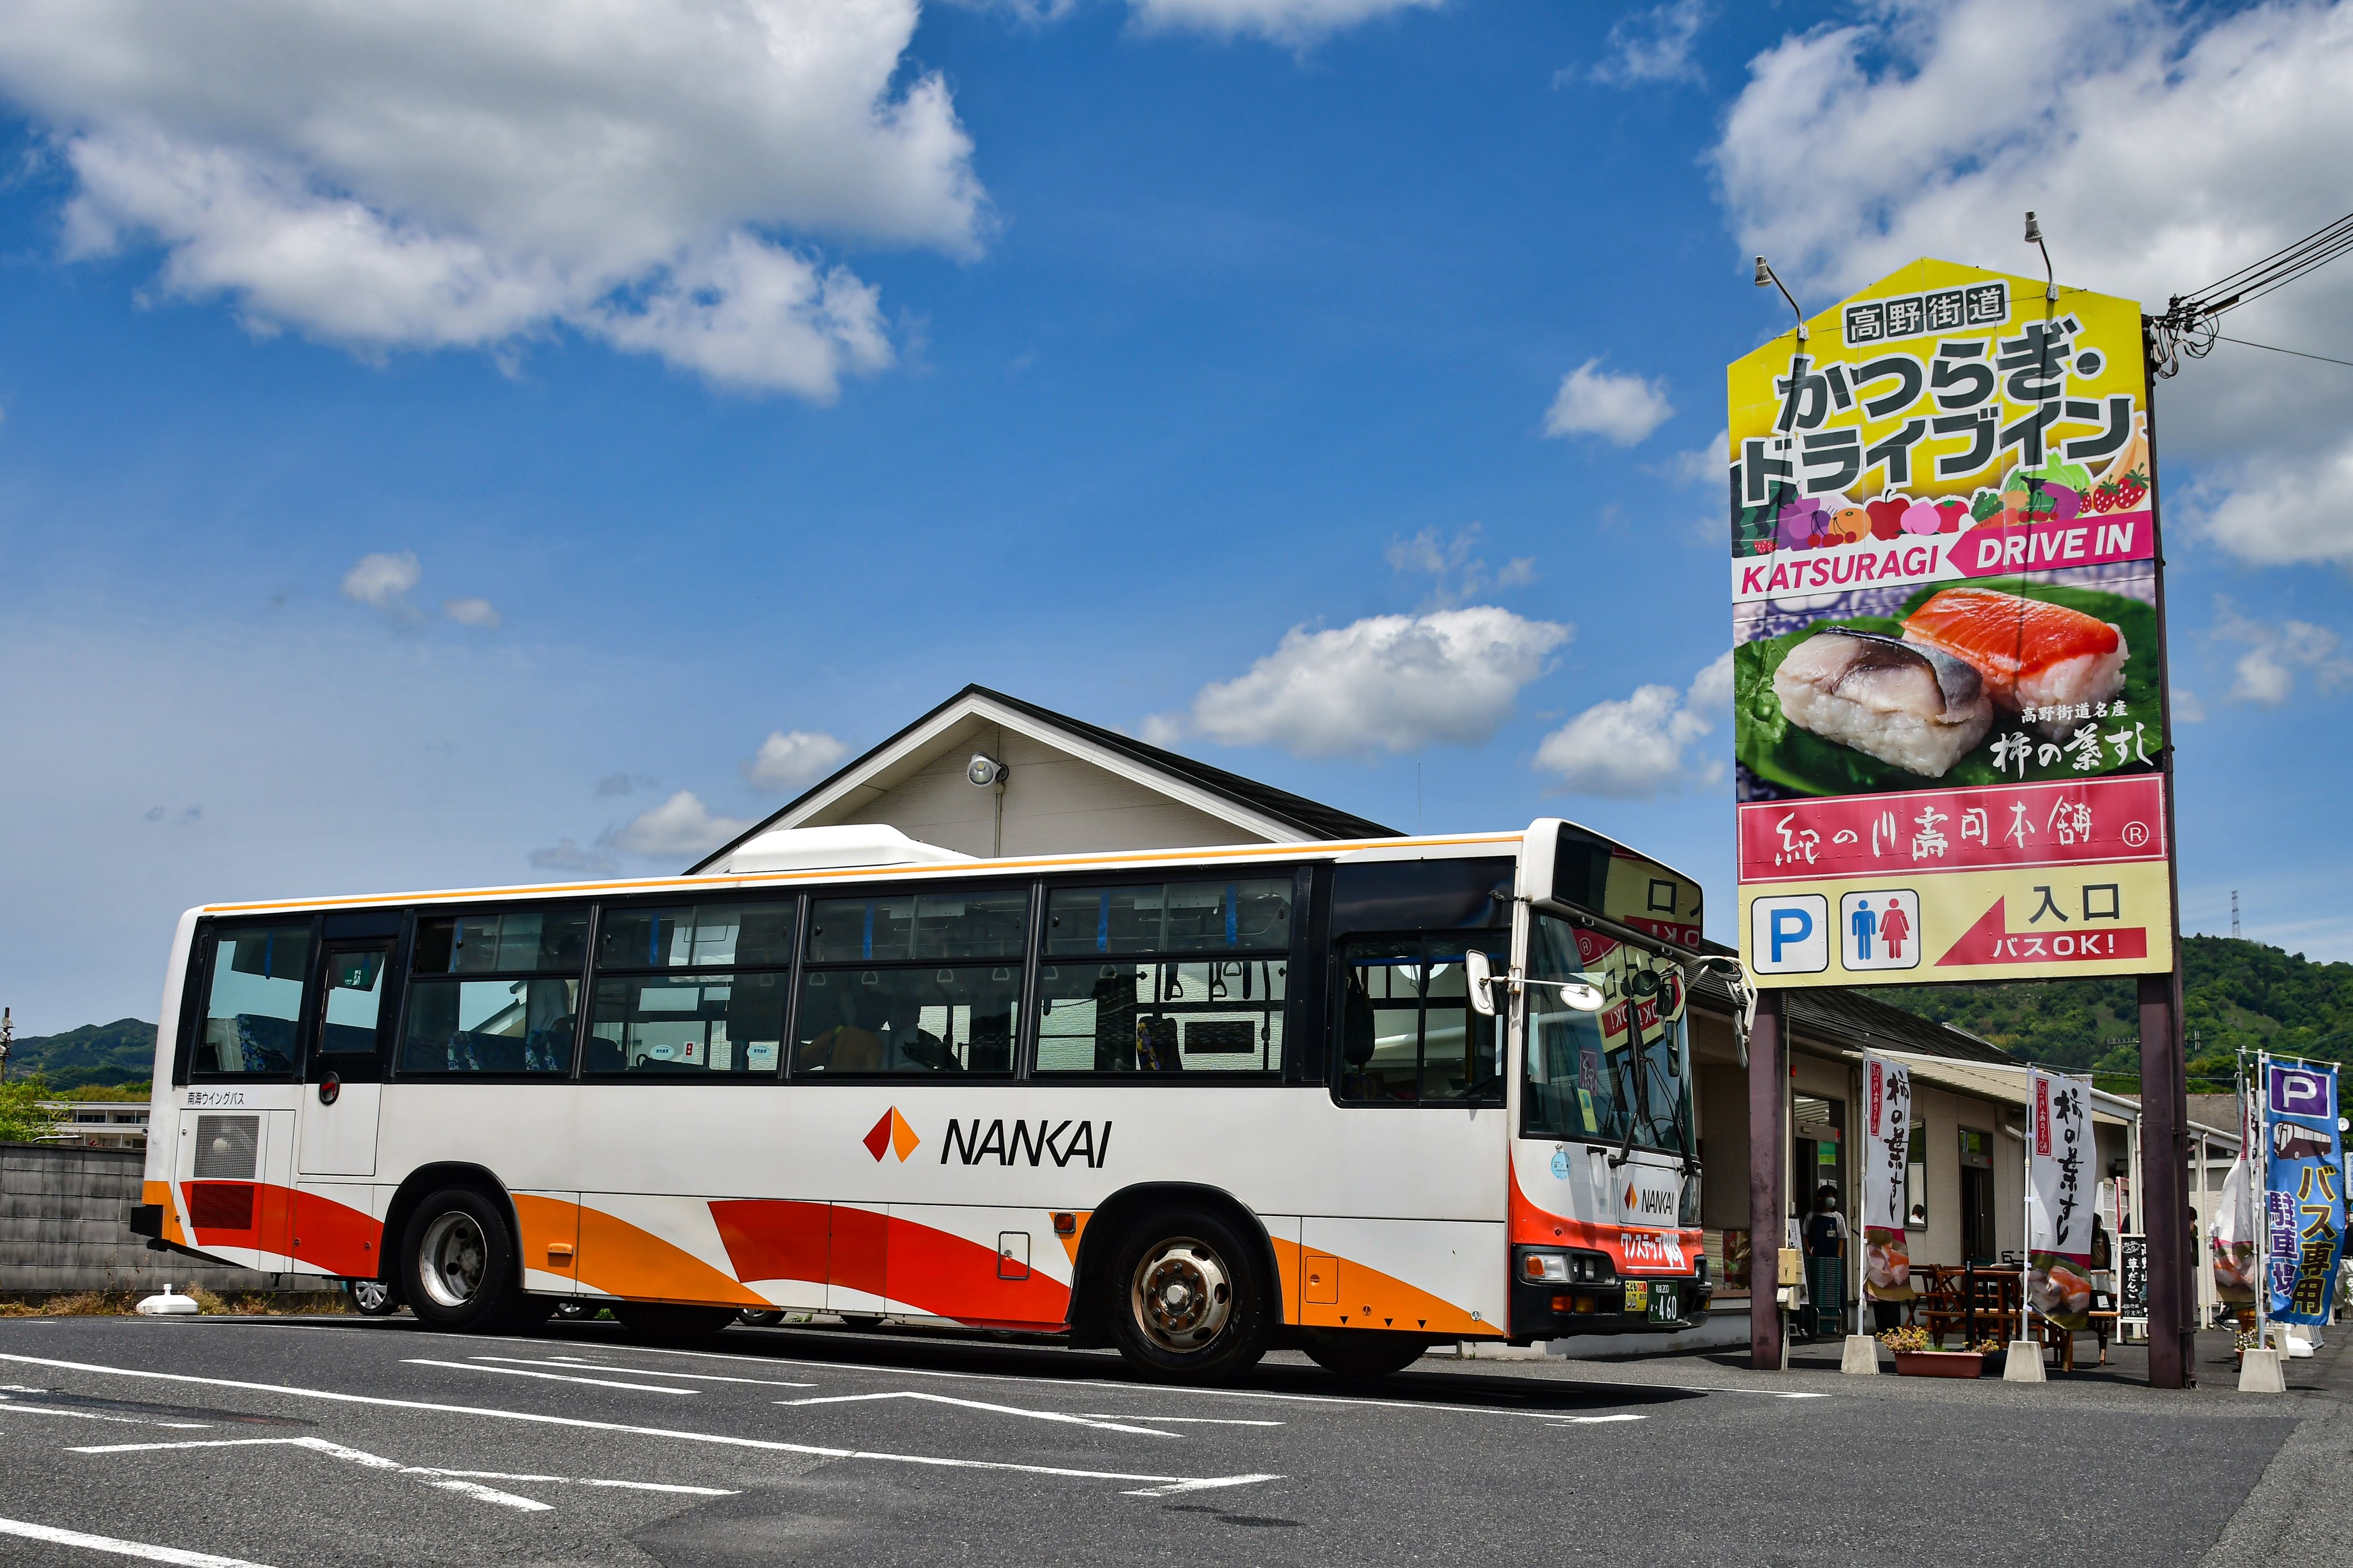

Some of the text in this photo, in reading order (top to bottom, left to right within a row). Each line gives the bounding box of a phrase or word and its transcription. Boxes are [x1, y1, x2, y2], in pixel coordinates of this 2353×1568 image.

[1848, 285, 2004, 341] 高野街道
[1746, 398, 2130, 501] ドライブイン
[1741, 523, 2134, 594] KATSURAGI DRIVE IN
[2021, 700, 2128, 723] 高野街道名産
[2028, 883, 2120, 924] 入口
[1771, 907, 1813, 963] P
[1993, 933, 2116, 958] バスOK!
[187, 1091, 244, 1105] 南海ウイングバス
[2283, 1075, 2318, 1110] P
[940, 1118, 1112, 1168] NANKAI
[1641, 1189, 1674, 1215] NANKAI
[2269, 1191, 2300, 1299] 駐車場
[2289, 1165, 2337, 1316] バス専用
[2126, 1257, 2139, 1299] 草だんご
